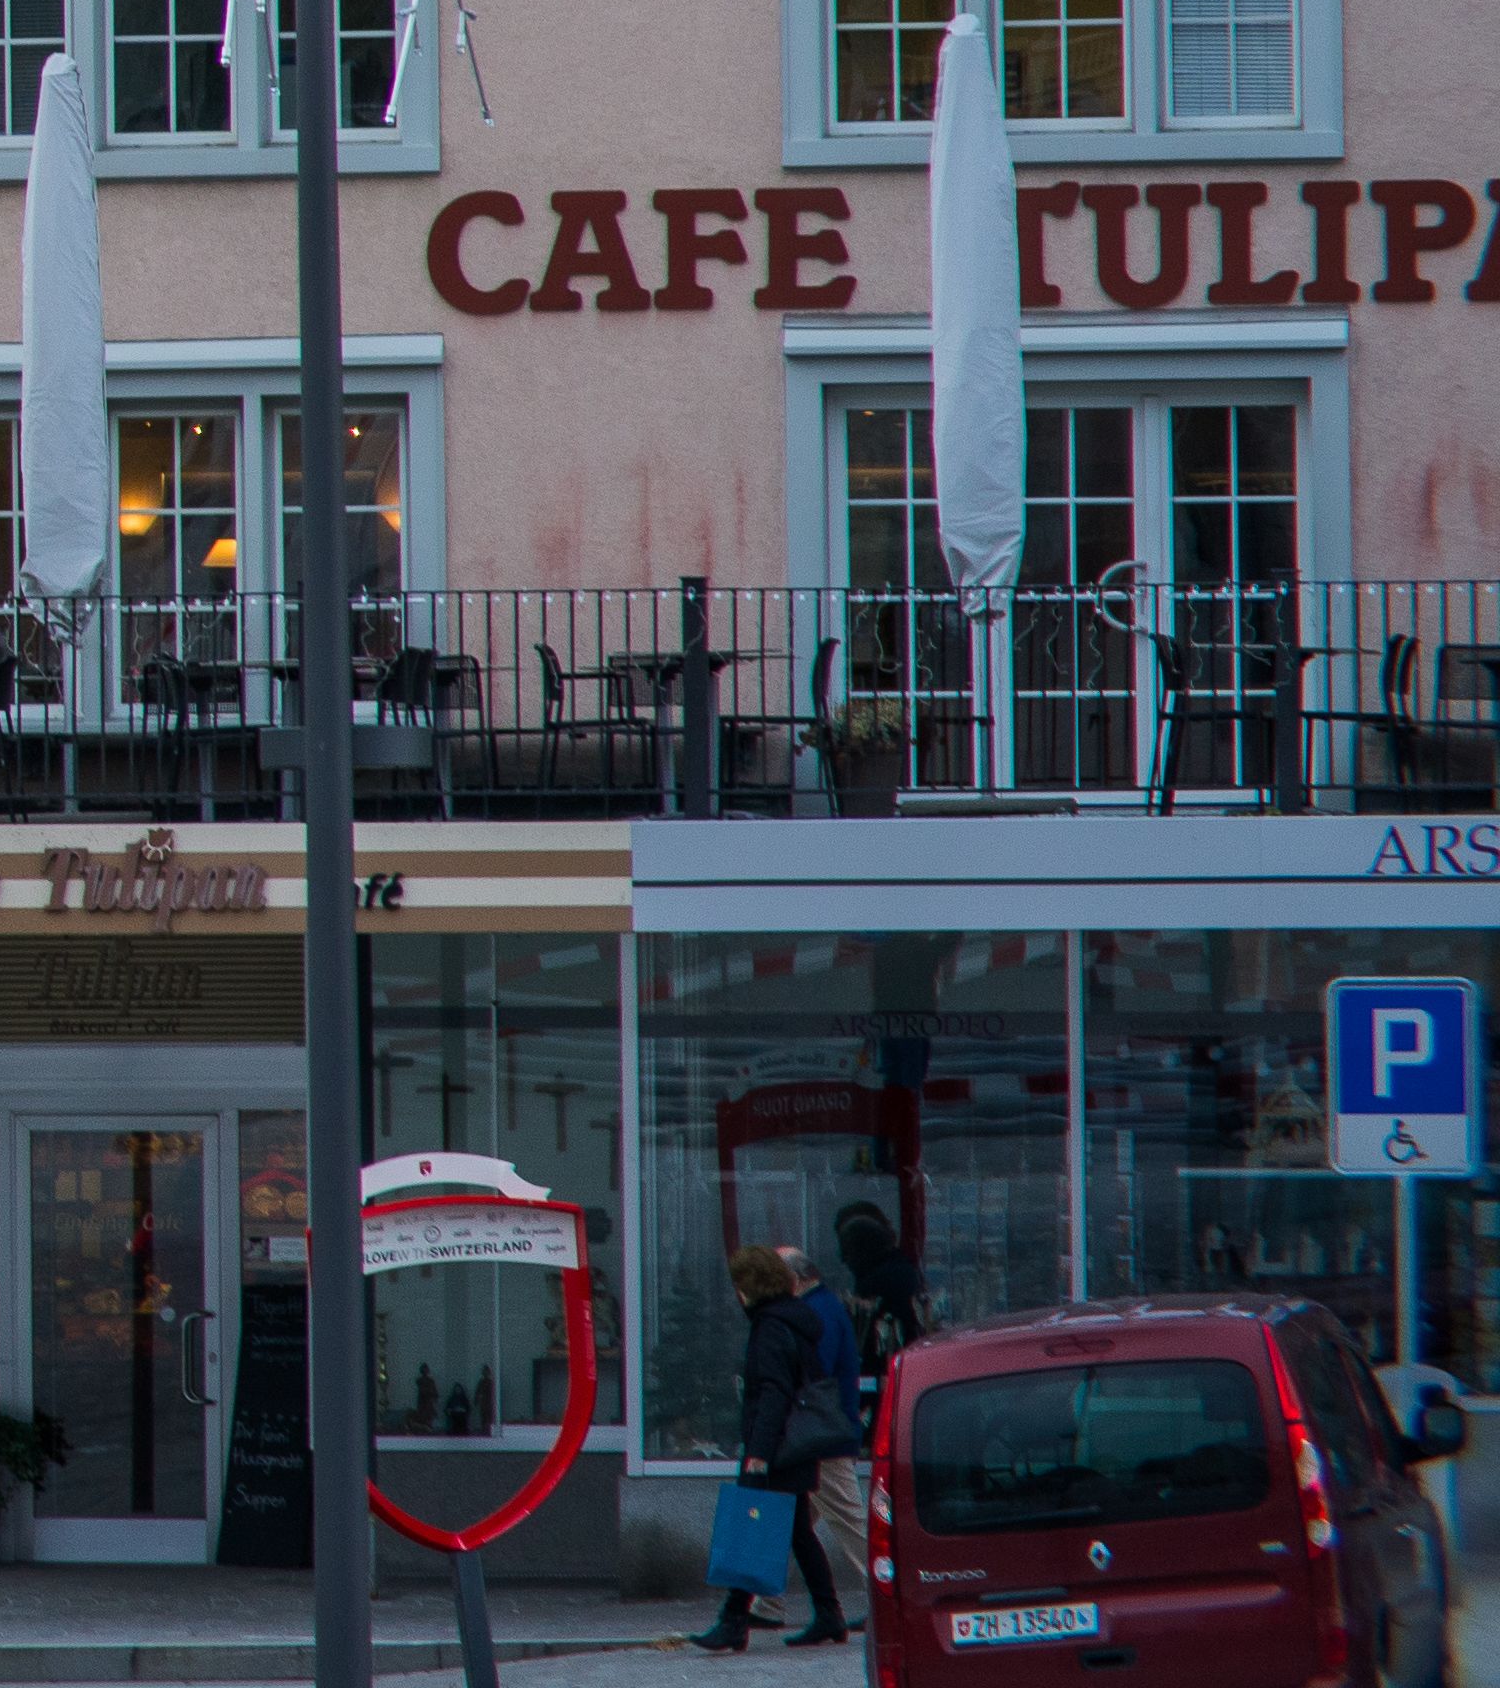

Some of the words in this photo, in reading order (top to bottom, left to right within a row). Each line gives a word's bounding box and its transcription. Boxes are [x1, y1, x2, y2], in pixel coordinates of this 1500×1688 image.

[426, 188, 857, 316] CAFE
[1017, 178, 1500, 310] TULIP
[43, 828, 271, 932] Tulipan
[1372, 1007, 1434, 1099] P
